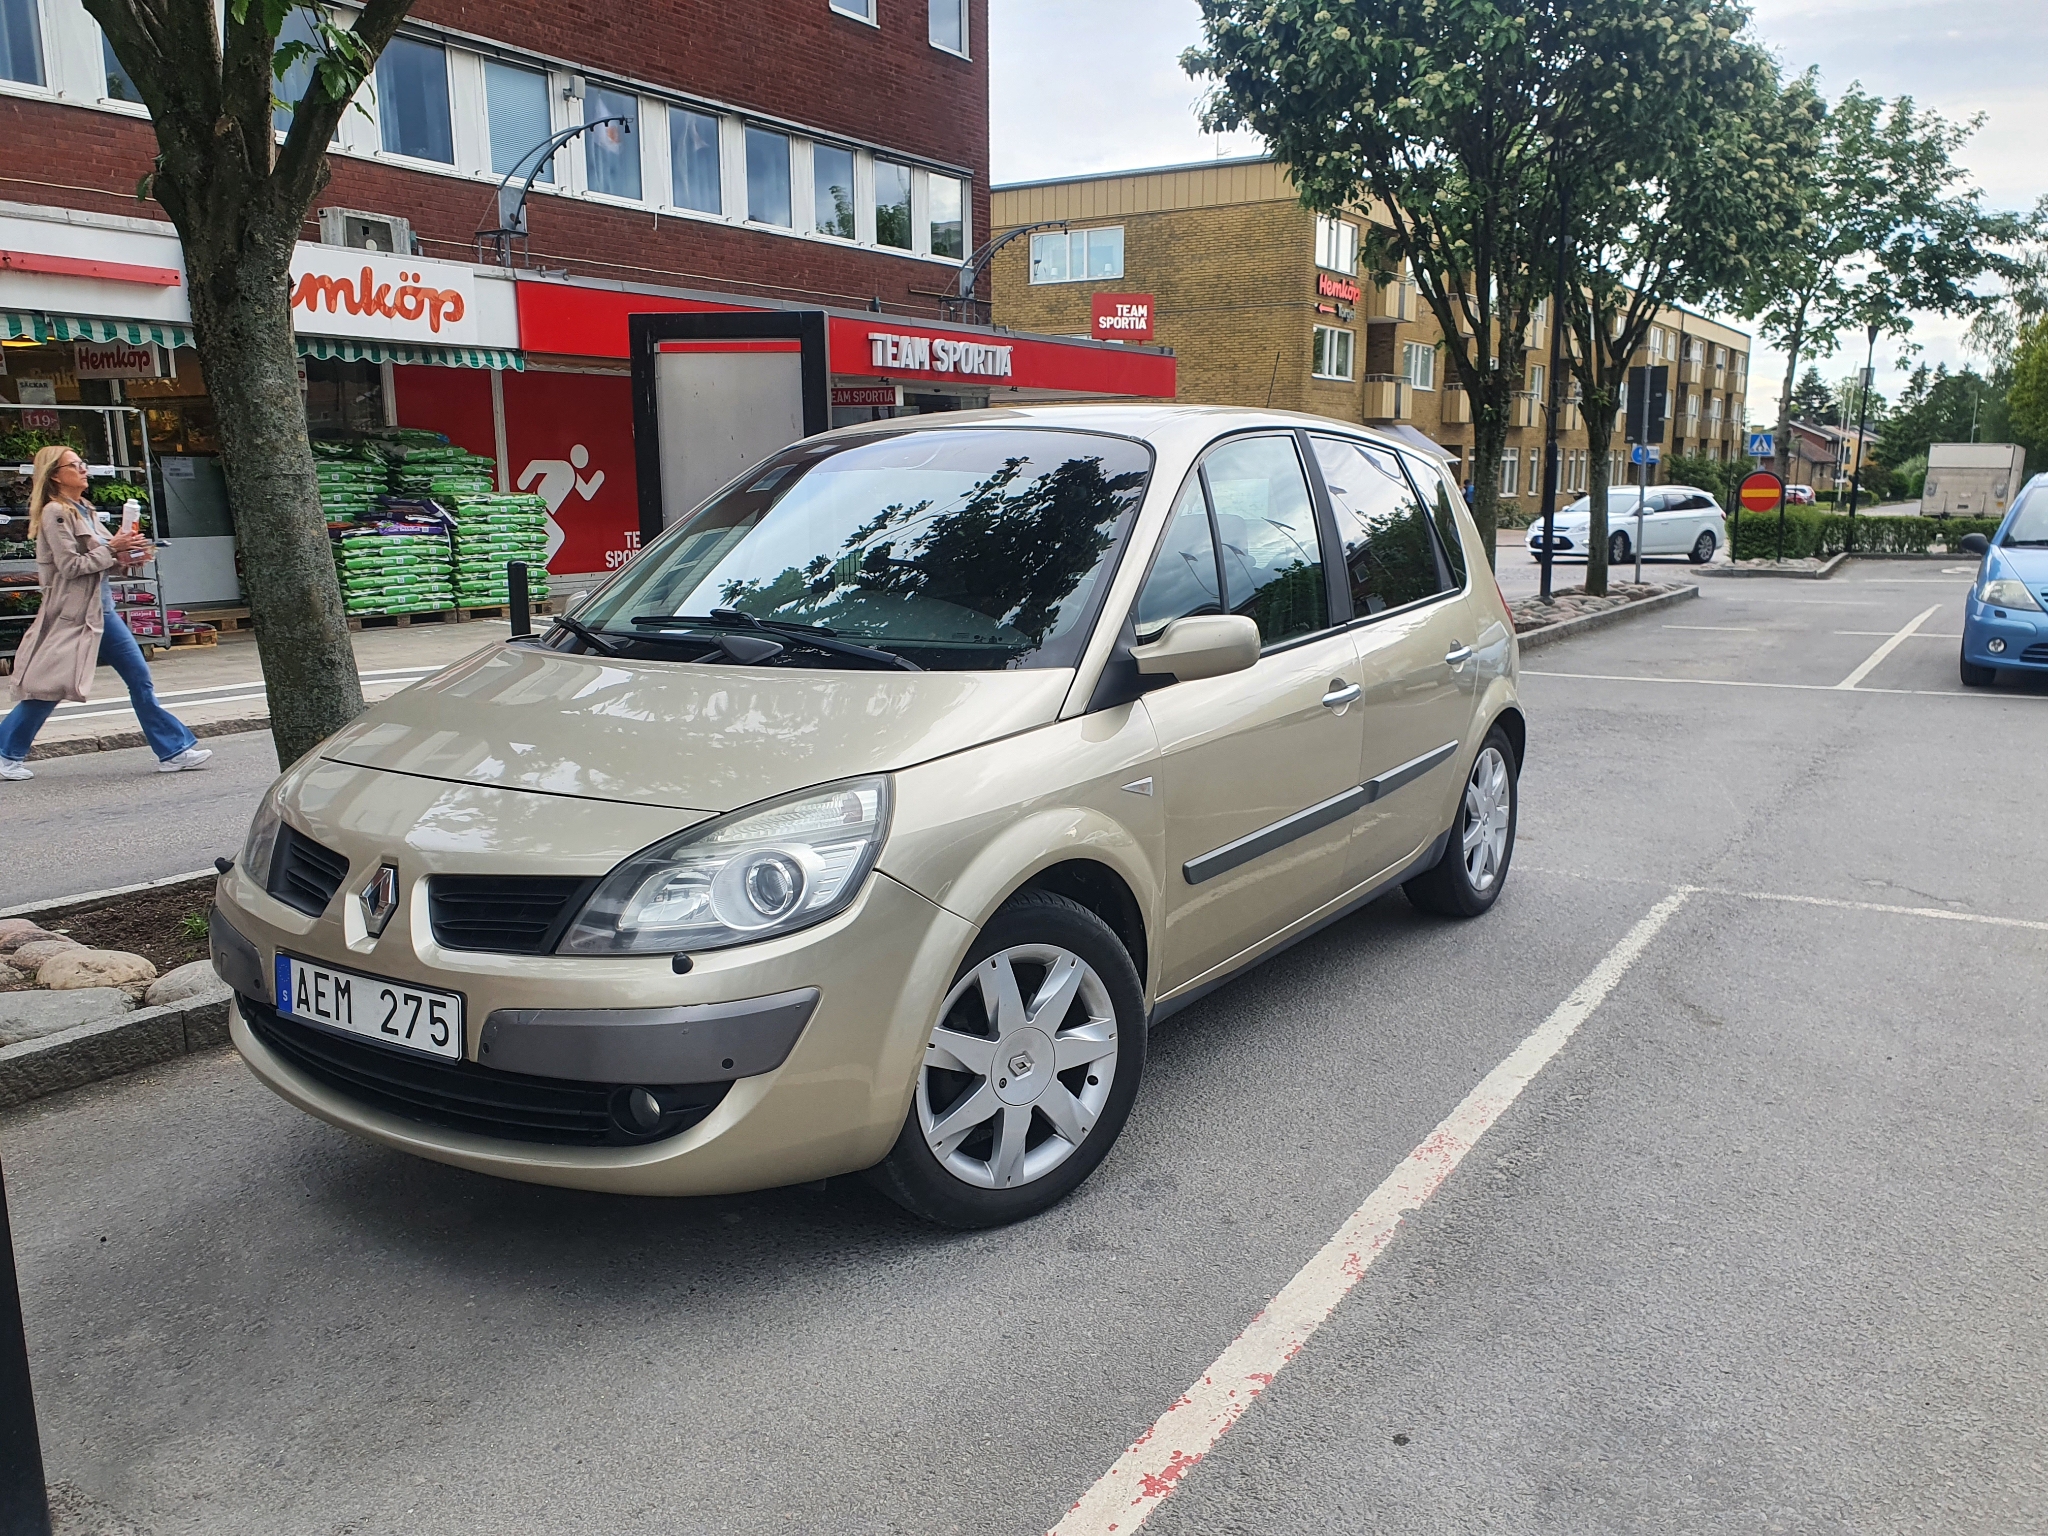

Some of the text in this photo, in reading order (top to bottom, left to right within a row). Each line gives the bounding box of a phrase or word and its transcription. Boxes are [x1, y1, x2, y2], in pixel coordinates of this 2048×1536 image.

[291, 266, 464, 333] mköp
[1318, 273, 1361, 305] Hemköp
[1115, 304, 1148, 317] TEAM
[1098, 316, 1147, 330] SPORTIA
[78, 345, 150, 372] Hemköp
[868, 332, 1013, 377] TEAM SPORTIA
[831, 389, 894, 403] EAM SPORTIA
[624, 531, 641, 548] TE
[282, 990, 288, 1002] S
[296, 967, 449, 1047] AEM 275
